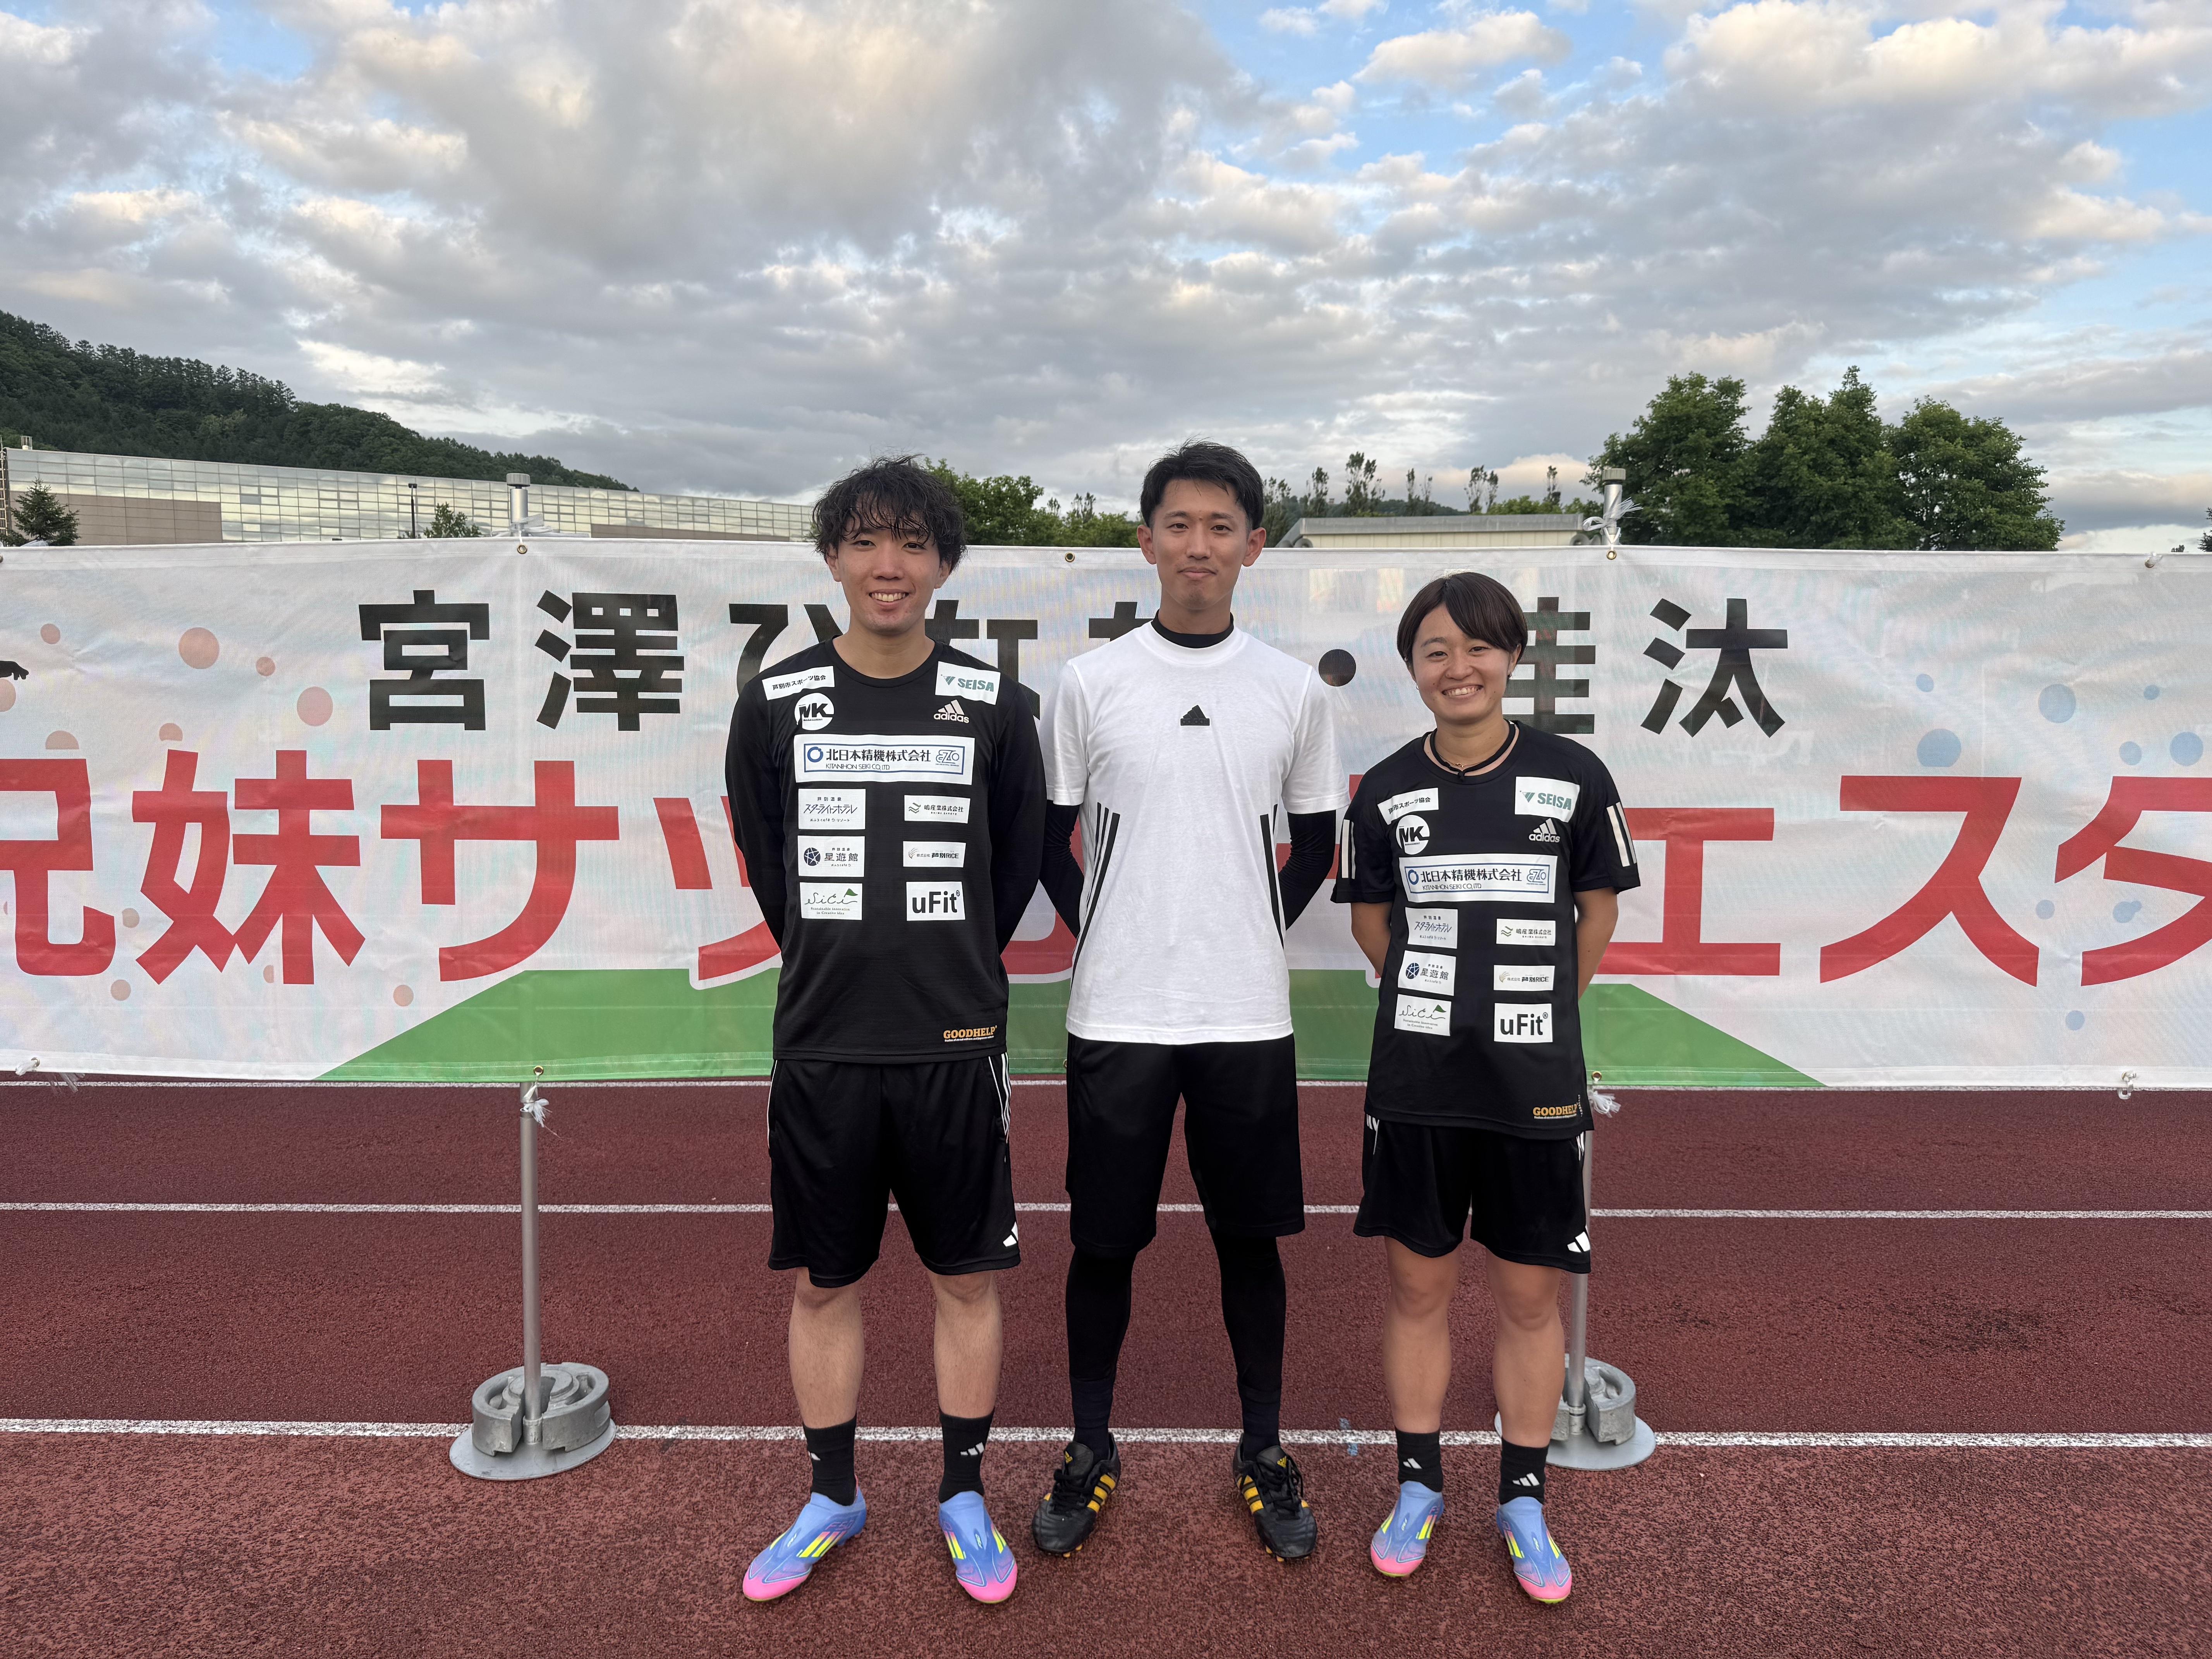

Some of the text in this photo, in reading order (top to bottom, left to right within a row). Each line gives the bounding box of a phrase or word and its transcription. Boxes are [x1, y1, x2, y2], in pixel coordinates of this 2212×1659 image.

[958, 678, 994, 692] SEISA
[934, 713, 969, 723] adidas
[826, 749, 931, 762] 北日本精機株式会社
[1537, 793, 1571, 811] SEISA
[804, 804, 857, 814] スターライトホテル
[1528, 833, 1560, 843] adidas
[824, 853, 858, 861] 星遊館
[1421, 868, 1522, 883] 北日本精機株式会社
[1414, 921, 1452, 933] スターライトホテル
[1420, 968, 1449, 980] 星遊館
[943, 1026, 995, 1039] GOODHELP
